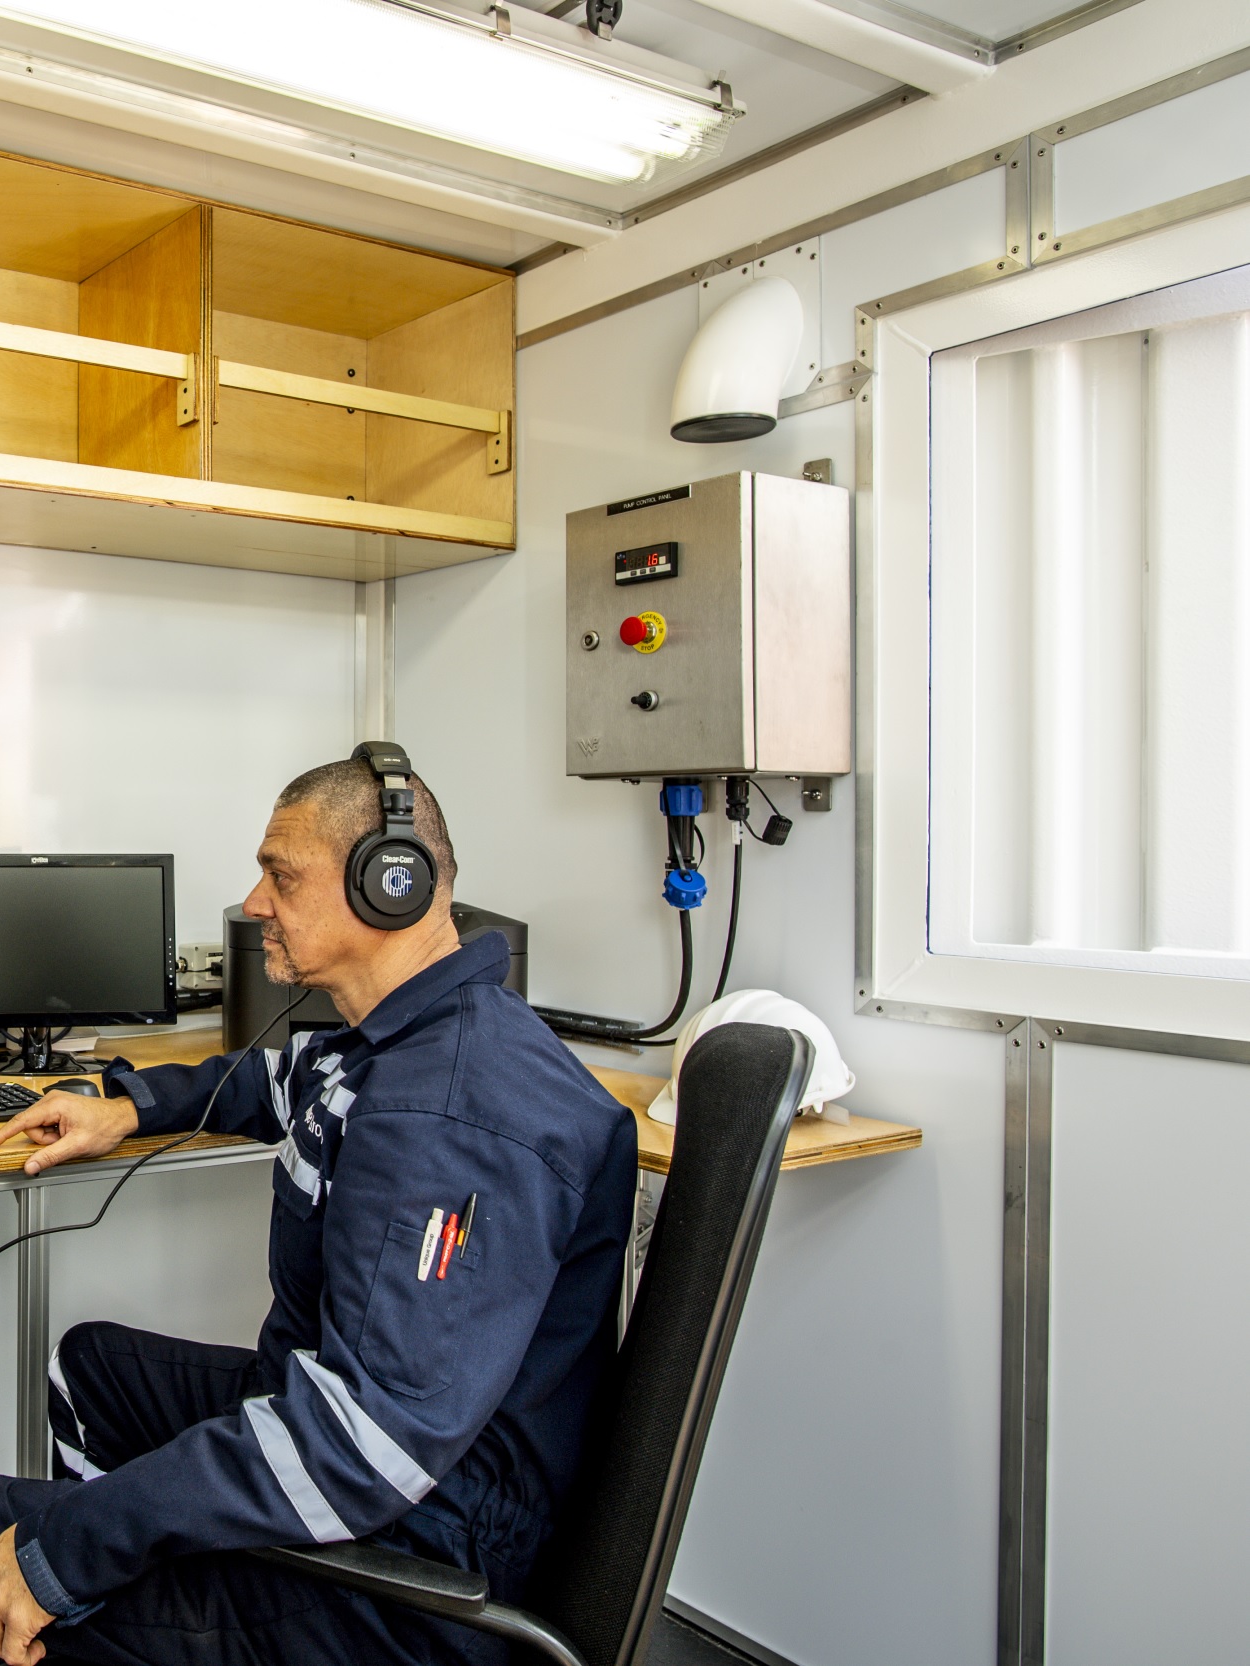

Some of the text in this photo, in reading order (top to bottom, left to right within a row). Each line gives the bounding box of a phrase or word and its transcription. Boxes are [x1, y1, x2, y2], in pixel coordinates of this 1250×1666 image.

[623, 493, 672, 509] PUMP CONTROL PANEL
[640, 643, 655, 652] STOP
[381, 854, 414, 864] Clear-Com
